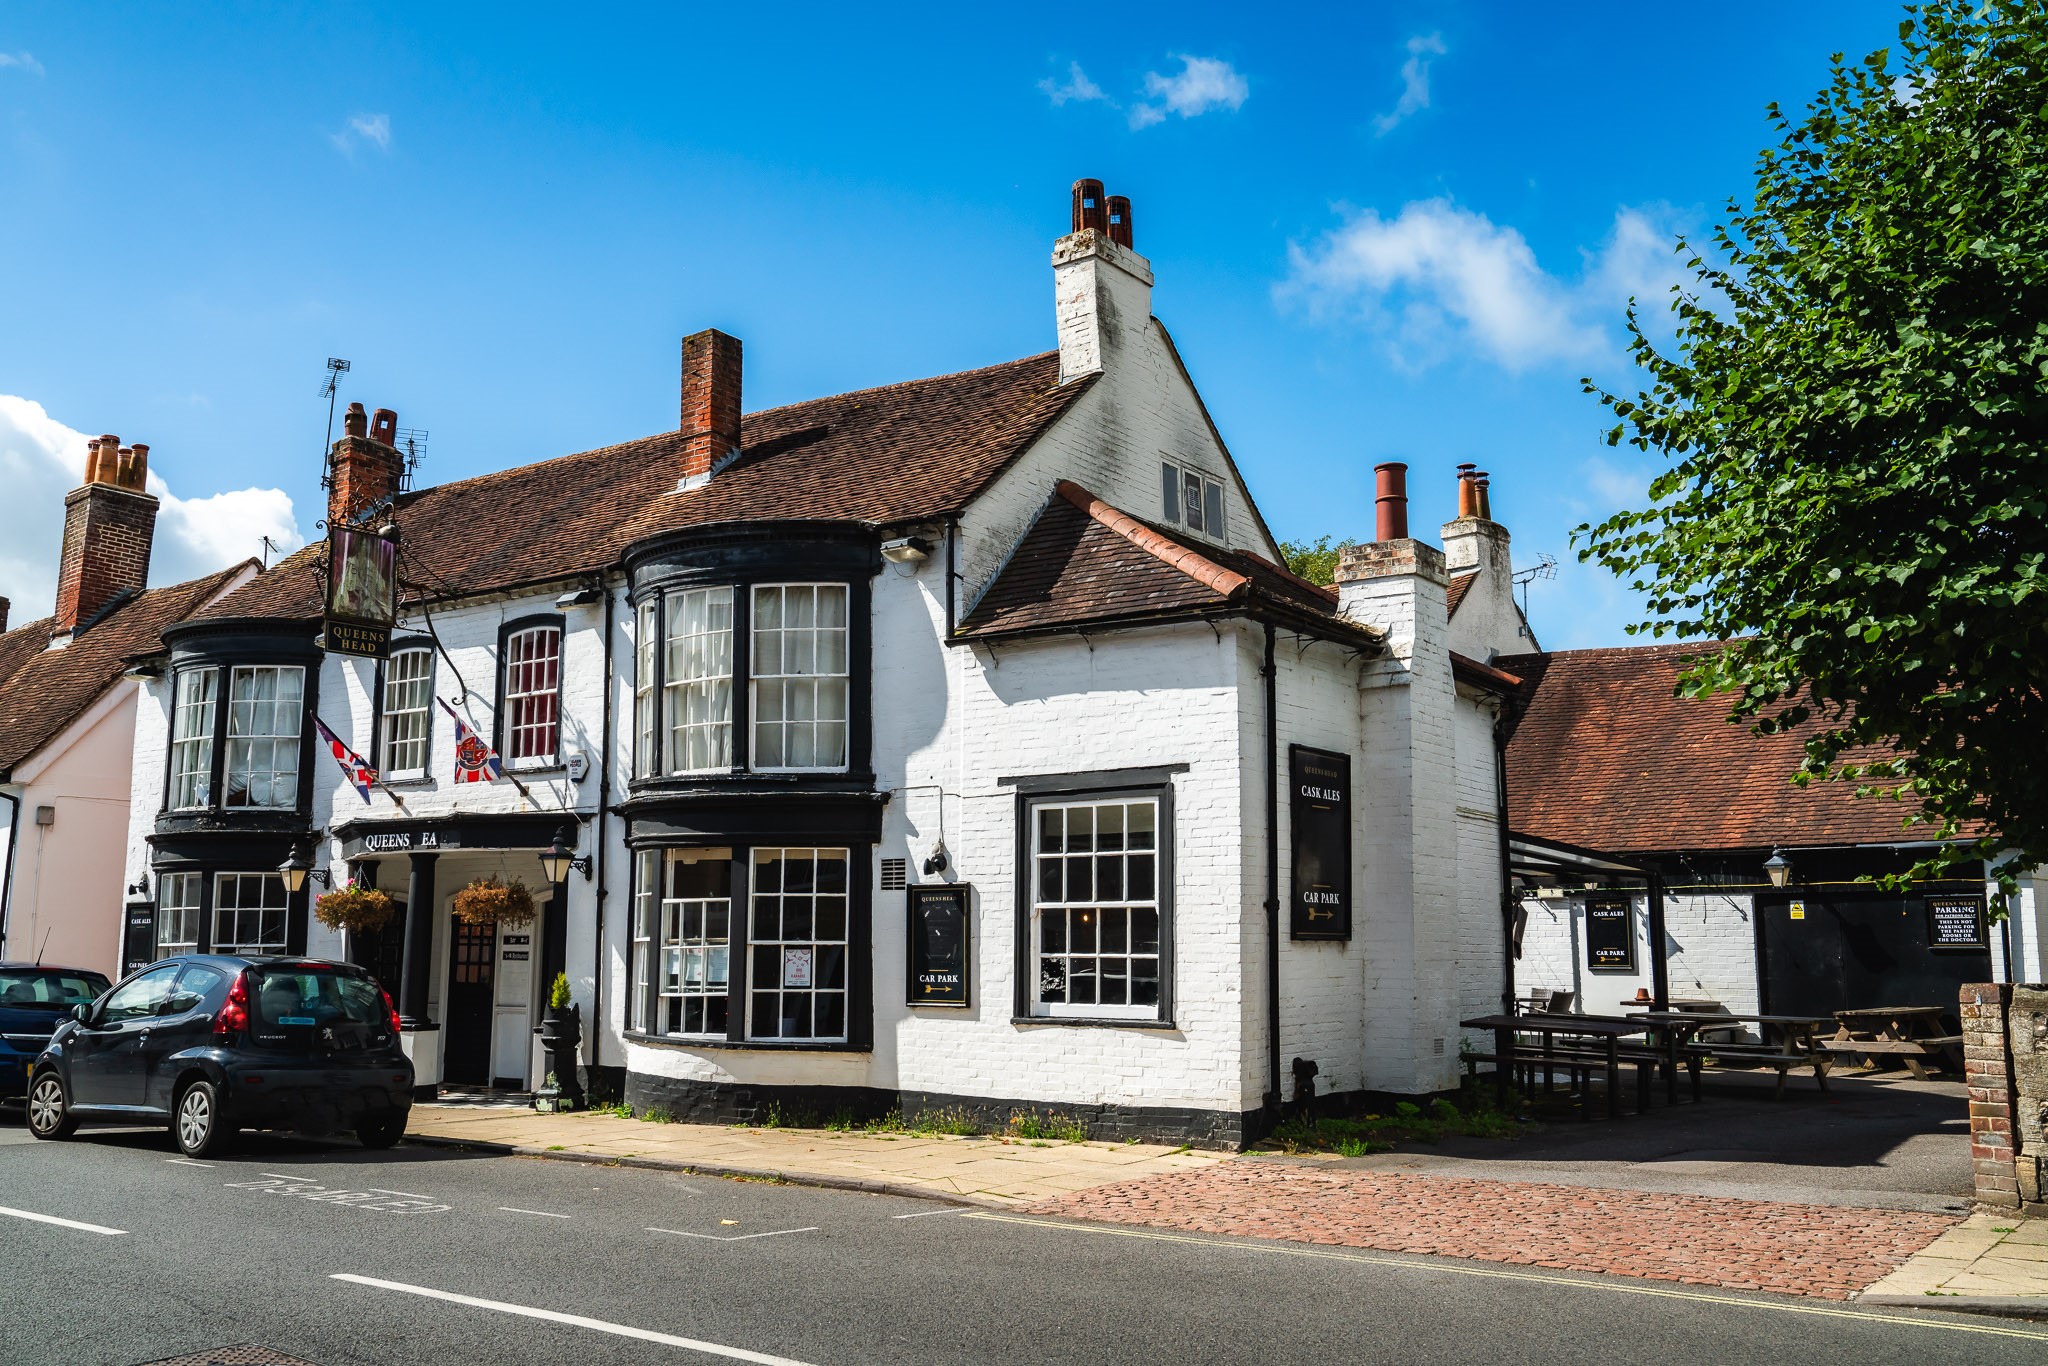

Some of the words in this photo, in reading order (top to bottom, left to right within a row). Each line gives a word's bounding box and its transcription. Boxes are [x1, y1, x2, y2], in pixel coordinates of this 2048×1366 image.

[333, 626, 385, 643] QUEENS
[341, 639, 376, 653] HEAD
[1301, 784, 1321, 799] CASK
[1322, 789, 1341, 801] ALES
[365, 833, 410, 851] QUEENS
[1303, 891, 1319, 903] CAR
[1320, 892, 1340, 904] PARK
[919, 974, 936, 983] CAR
[937, 974, 959, 983] PARK
[223, 1180, 452, 1214] DISABLED
